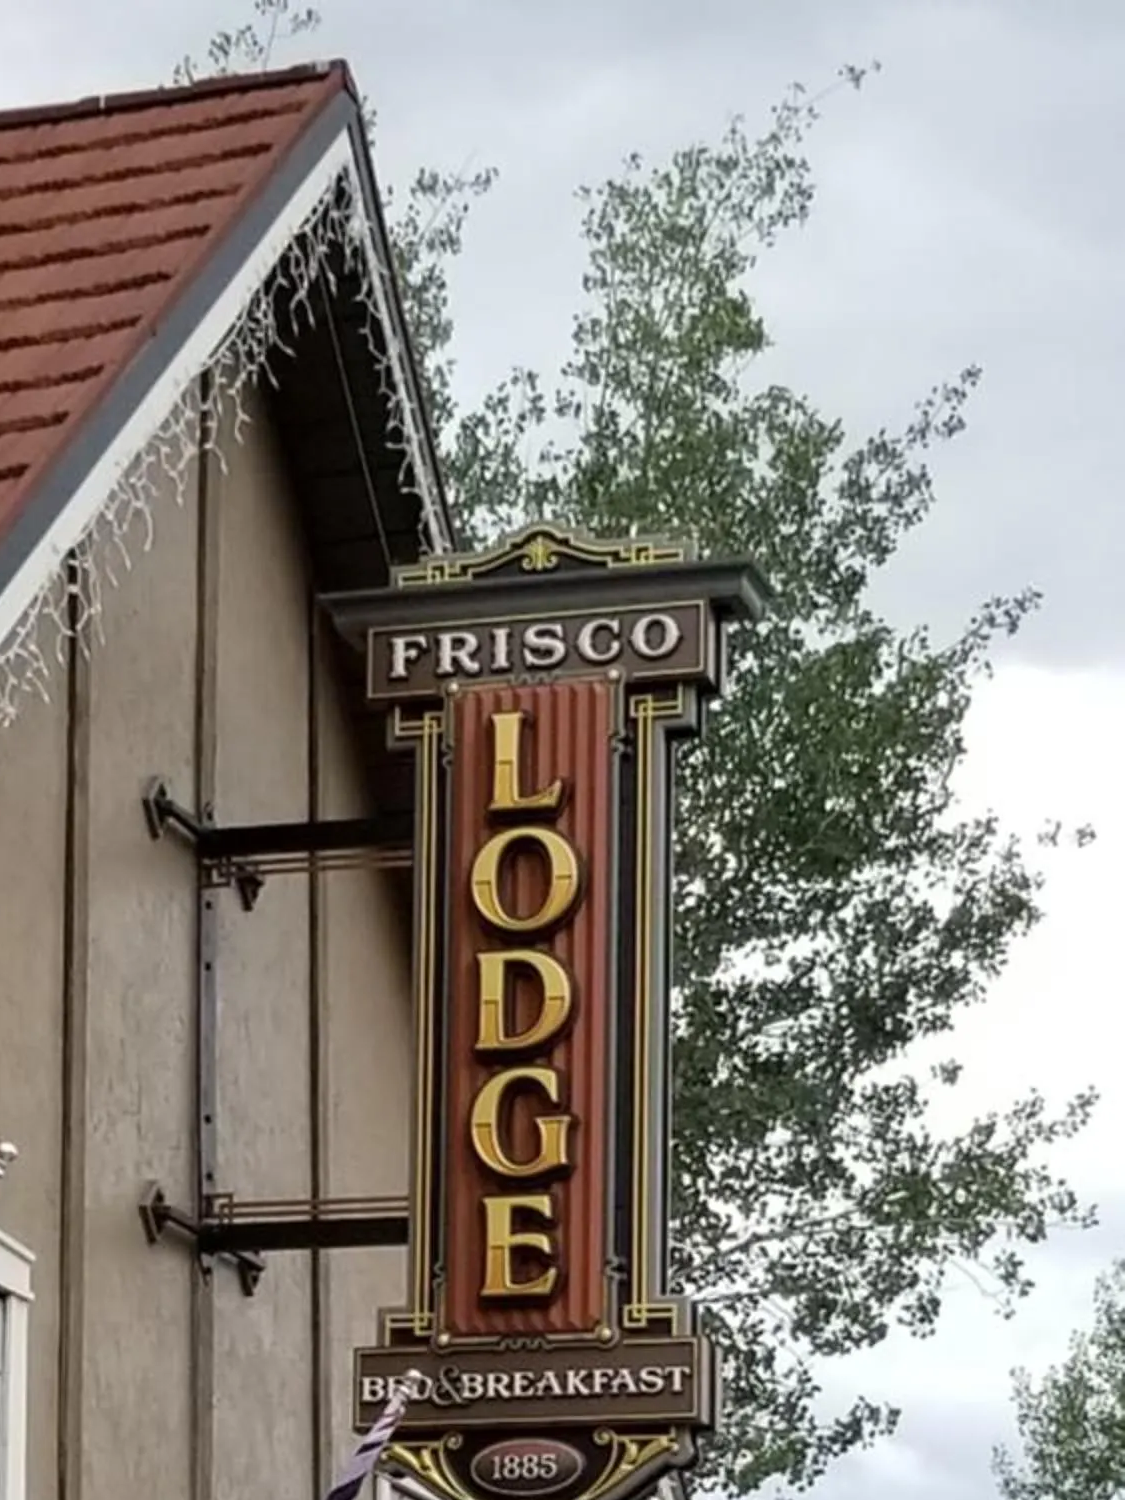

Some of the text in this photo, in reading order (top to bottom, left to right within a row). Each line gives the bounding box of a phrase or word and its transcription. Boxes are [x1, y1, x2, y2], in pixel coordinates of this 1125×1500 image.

[387, 612, 682, 680] FRISCO
[470, 710, 579, 1298] LODGE
[461, 1365, 692, 1399] BREAKFAST
[491, 1453, 558, 1480] 1885
